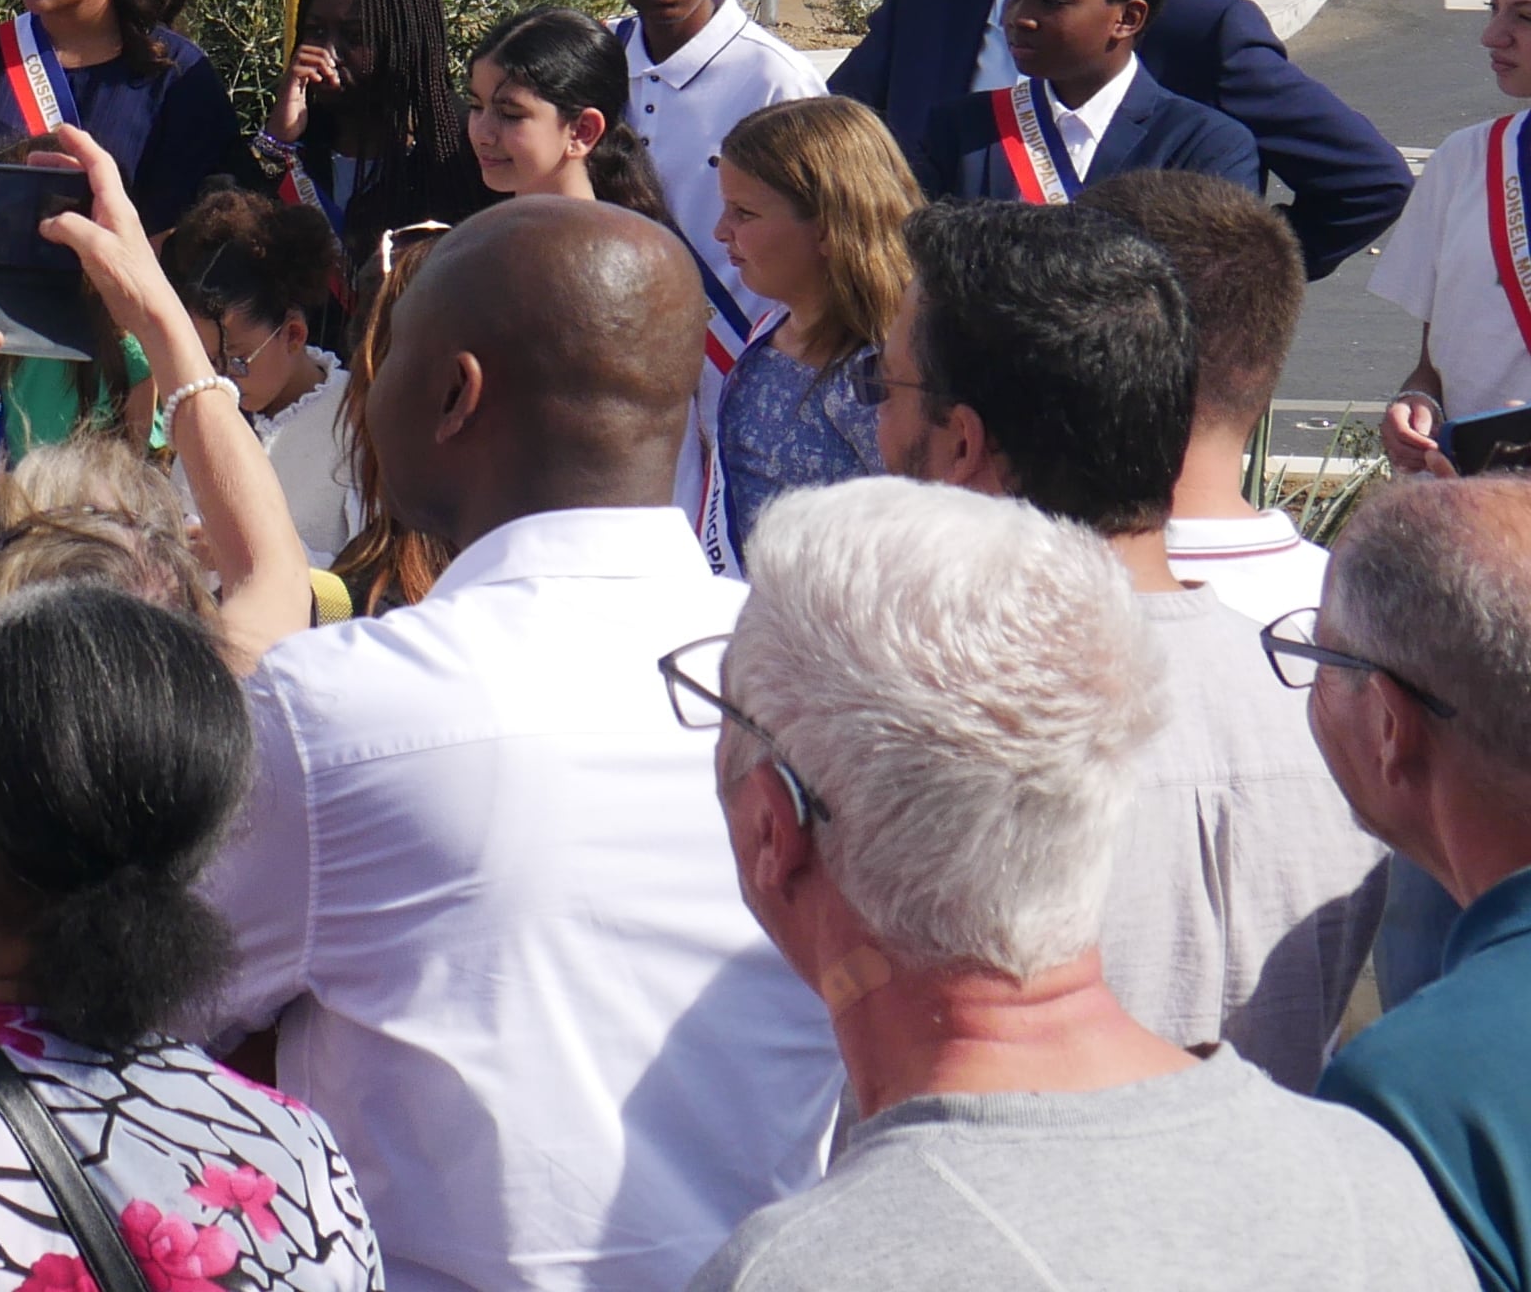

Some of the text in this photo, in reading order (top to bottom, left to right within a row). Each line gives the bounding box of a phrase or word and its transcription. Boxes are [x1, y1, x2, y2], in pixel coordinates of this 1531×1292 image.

[25, 53, 58, 120] CONSEIL
[1019, 109, 1059, 188] MUNICIPAL
[1505, 175, 1527, 255] CONSEIL
